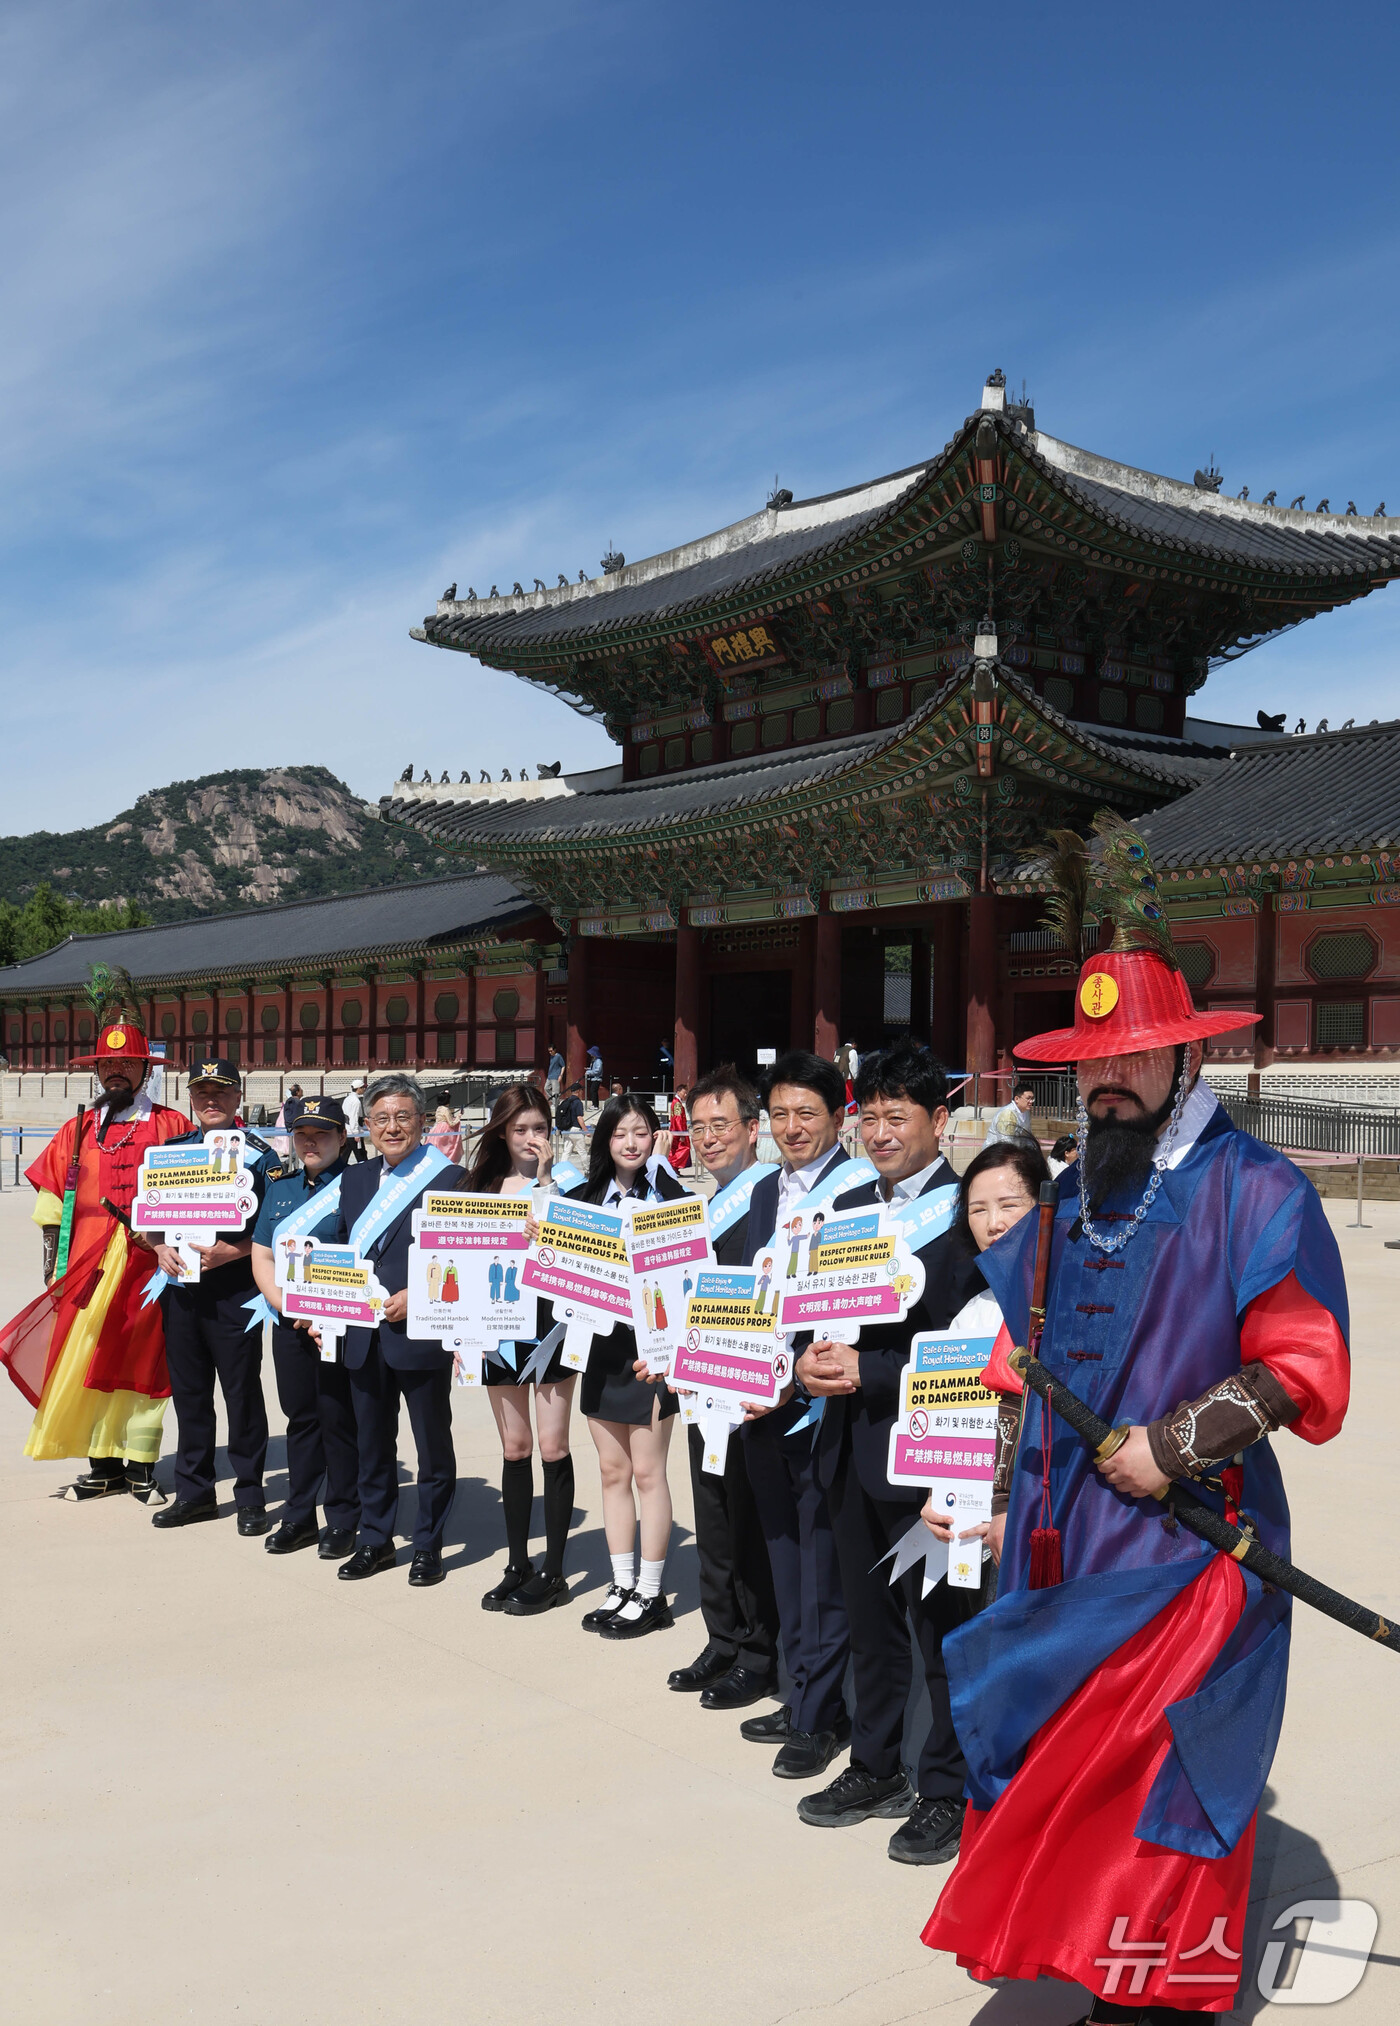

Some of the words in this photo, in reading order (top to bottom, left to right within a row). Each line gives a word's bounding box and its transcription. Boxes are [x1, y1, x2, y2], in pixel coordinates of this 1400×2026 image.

[1092, 976, 1104, 1015] 종사관
[160, 1169, 208, 1178] FLAMMABLES
[159, 1177, 205, 1186] DANGEROUS
[553, 1212, 571, 1222] Royal
[572, 1217, 599, 1230] Heritage
[600, 1224, 618, 1233] Tour!
[634, 1213, 655, 1224] FOLLOW
[656, 1208, 688, 1219] GUIDELINES
[635, 1220, 657, 1232] PROPER
[658, 1216, 681, 1227] HANBOK
[683, 1213, 701, 1223] ATTIRE
[438, 1236, 508, 1246] 遵守标准韩服规定
[543, 1227, 556, 1235] NO
[558, 1230, 617, 1249] FLAMMABLES
[667, 1232, 682, 1242] 가이드
[683, 1229, 693, 1238] 준수
[541, 1236, 554, 1245] OR
[556, 1239, 611, 1257] DANGEROUS
[820, 1248, 846, 1257] RESPECT
[847, 1245, 872, 1253] OTHERS
[819, 1258, 844, 1266] FOLLOW
[846, 1254, 868, 1263] PUBLIC
[870, 1252, 890, 1260] RULES
[561, 1256, 574, 1266] 화기
[576, 1260, 582, 1268] 및
[584, 1262, 603, 1275] 위험한
[604, 1267, 617, 1279] 소품
[797, 1280, 810, 1291] 질서
[812, 1278, 825, 1289] 유지
[829, 1277, 835, 1287] 및
[837, 1274, 860, 1286] 정숙한
[862, 1272, 877, 1284] 관람
[715, 1286, 737, 1296] Heritage
[738, 1287, 752, 1295] Tour!
[703, 1305, 750, 1314] FLAMMABLES
[701, 1317, 745, 1326] DANGEROUS
[747, 1319, 771, 1327] PROPS
[705, 1335, 715, 1344] 화기
[716, 1337, 721, 1346] 및
[722, 1337, 738, 1348] 위험한
[762, 1345, 773, 1355] 금지
[922, 1346, 937, 1354] Safe
[943, 1345, 960, 1354] Enjoy
[922, 1354, 943, 1366] Royal
[944, 1354, 975, 1365] Heritage
[912, 1380, 927, 1390] NO
[912, 1395, 925, 1404] OR
[928, 1390, 991, 1404] DANGEROUS
[935, 1416, 950, 1427] 화기
[952, 1418, 959, 1428] 및
[961, 1417, 984, 1430] 위험한
